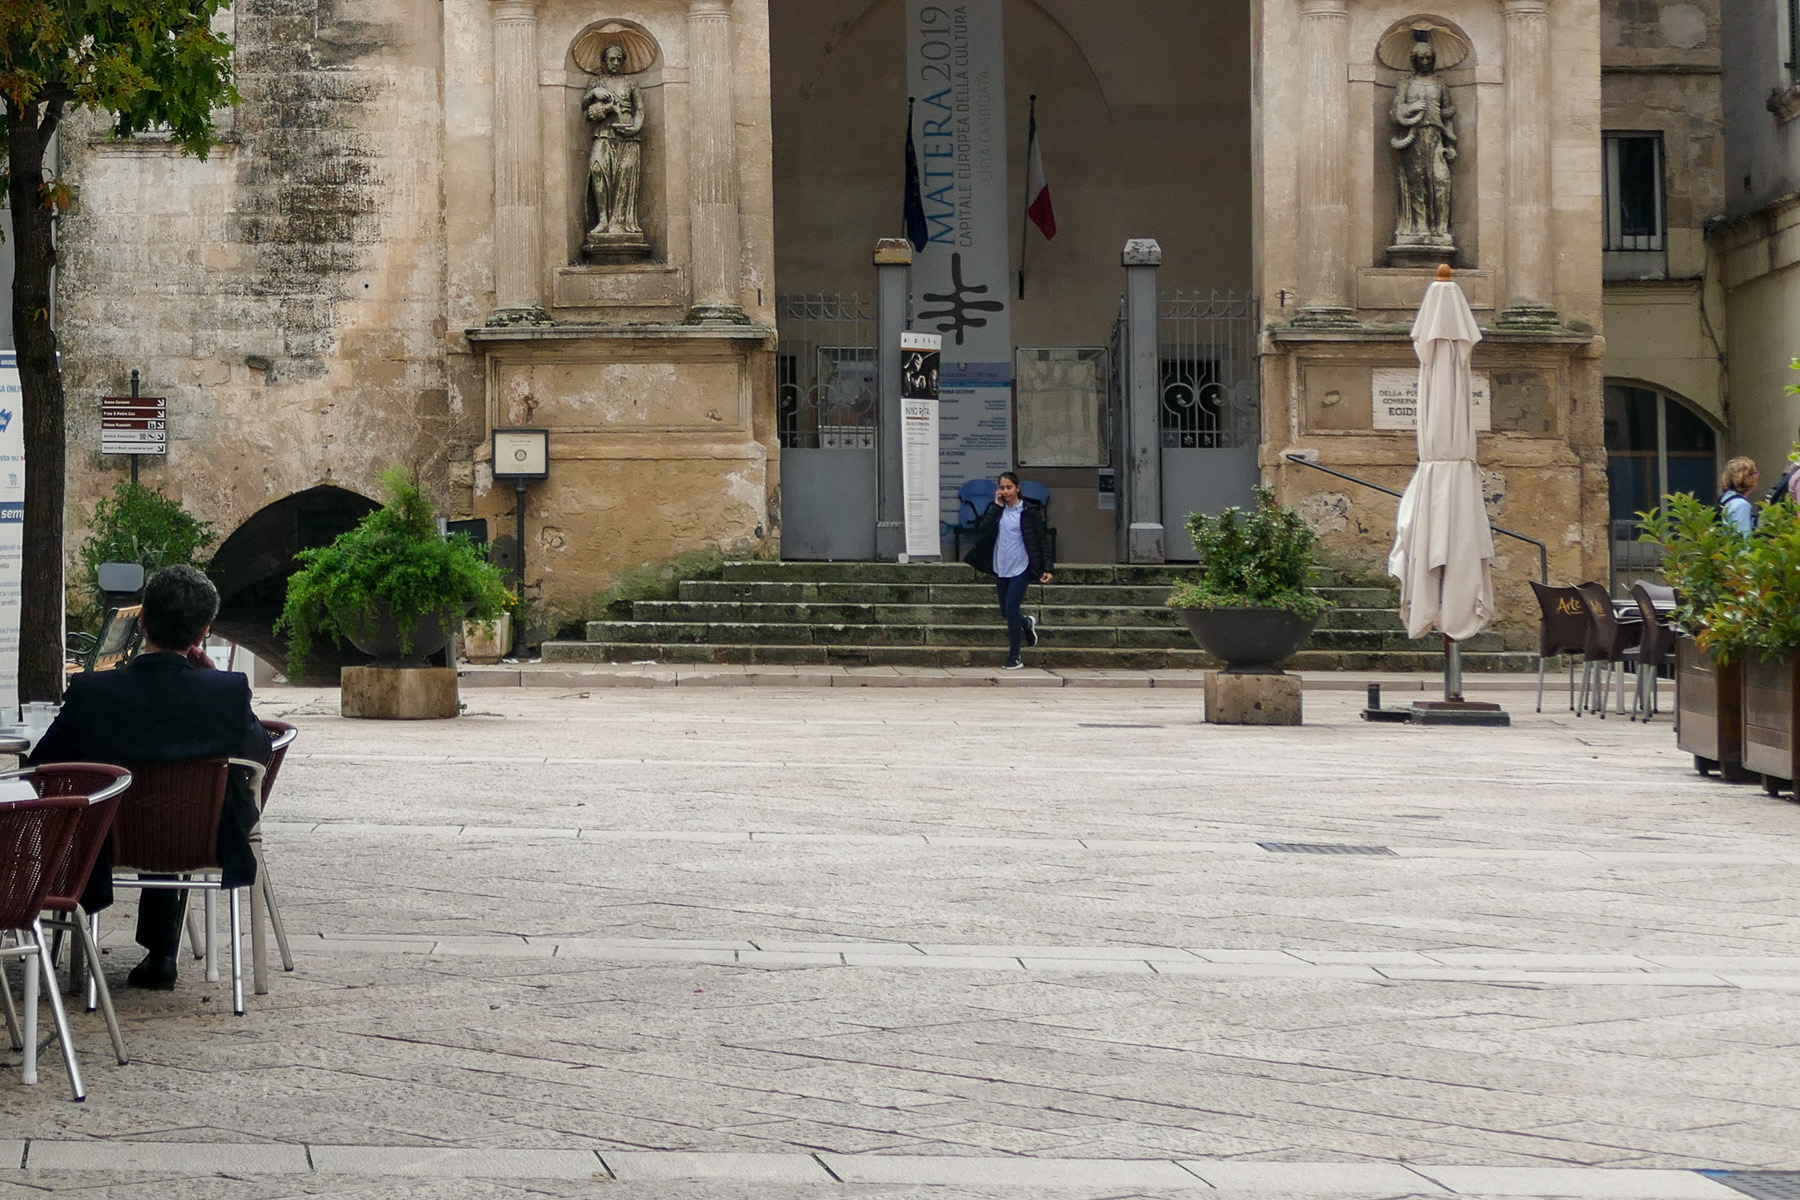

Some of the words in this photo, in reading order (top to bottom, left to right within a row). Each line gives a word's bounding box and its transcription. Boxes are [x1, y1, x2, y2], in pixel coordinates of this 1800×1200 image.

[920, 5, 951, 82] 2019
[953, 5, 968, 67] CULTURA
[955, 70, 970, 114] DELLA
[922, 88, 955, 246] MATERA
[957, 116, 971, 180] EUROPEA
[959, 183, 972, 248] CAPITALE
[7, 385, 21, 393] ONLI
[1388, 407, 1417, 416] EGIDI
